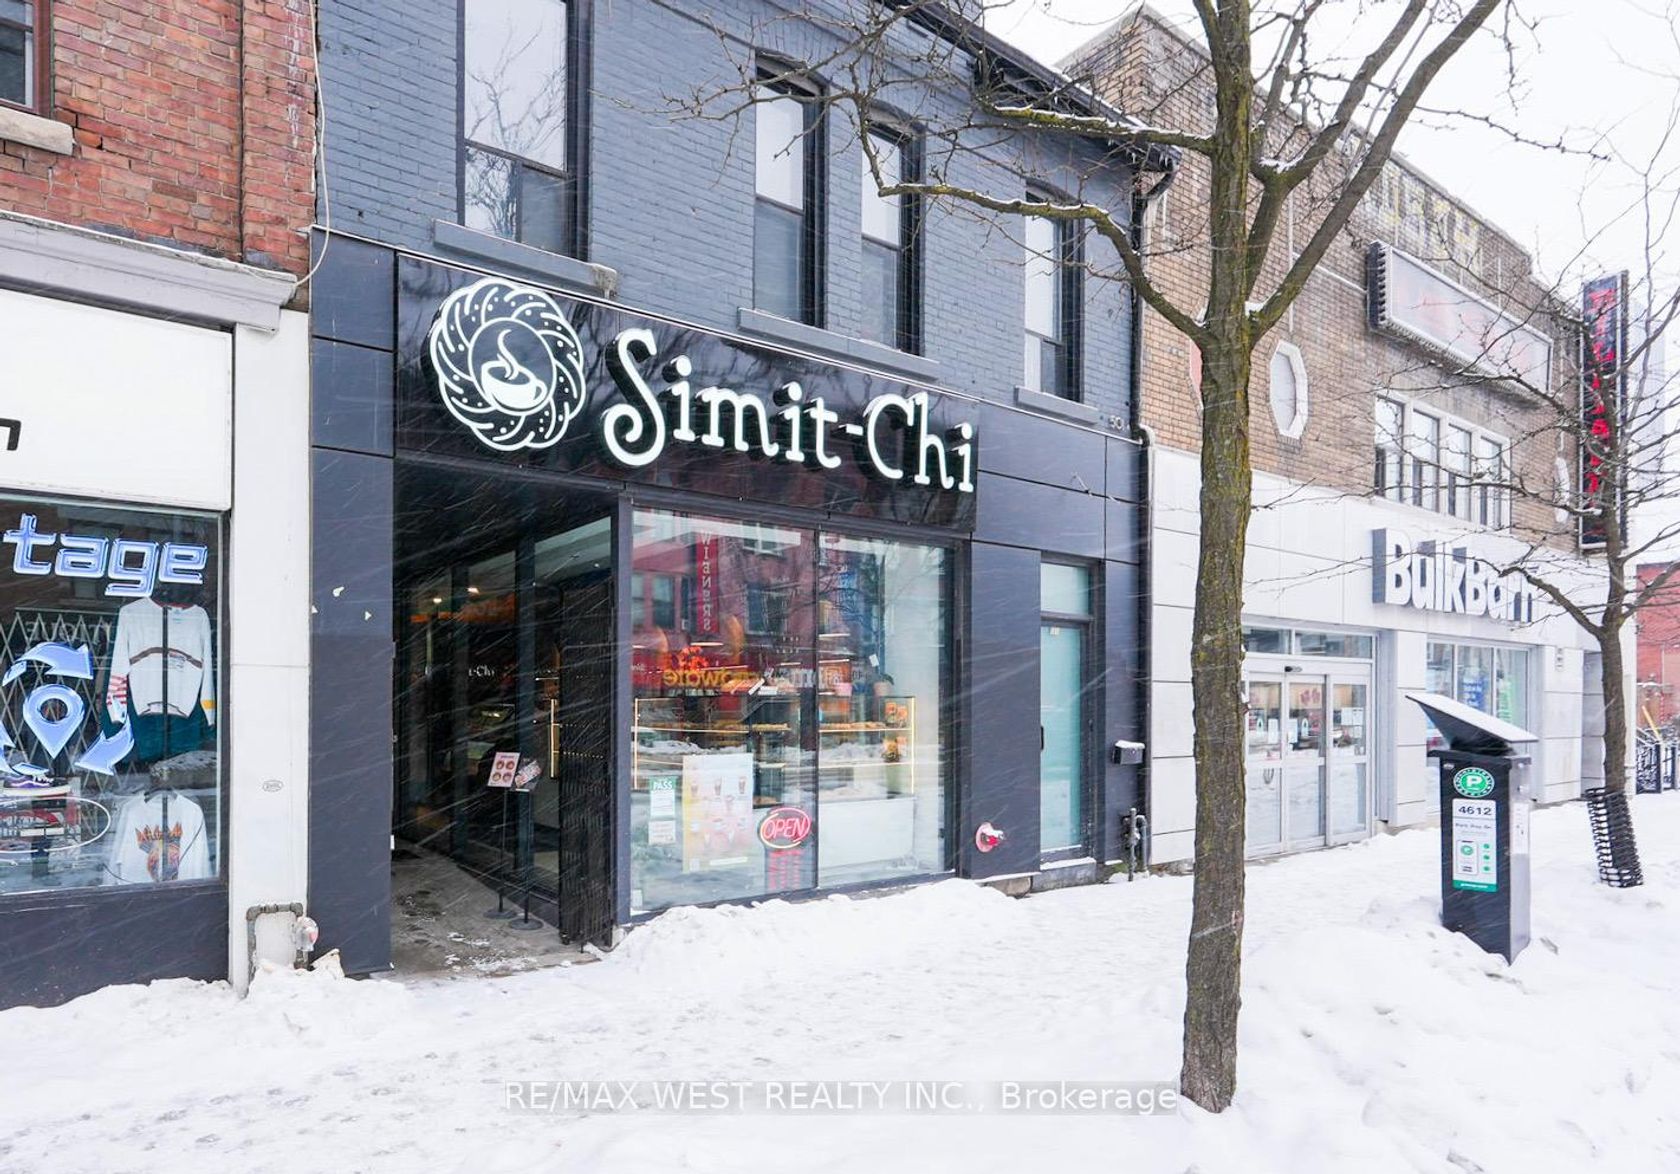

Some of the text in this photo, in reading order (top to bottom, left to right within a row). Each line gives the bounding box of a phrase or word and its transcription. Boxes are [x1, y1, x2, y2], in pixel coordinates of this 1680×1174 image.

[604, 328, 974, 492] Simit-Chi
[3, 513, 208, 597] tage
[653, 781, 673, 791] PASS
[1458, 806, 1492, 816] 4612
[763, 817, 807, 840] OPEN
